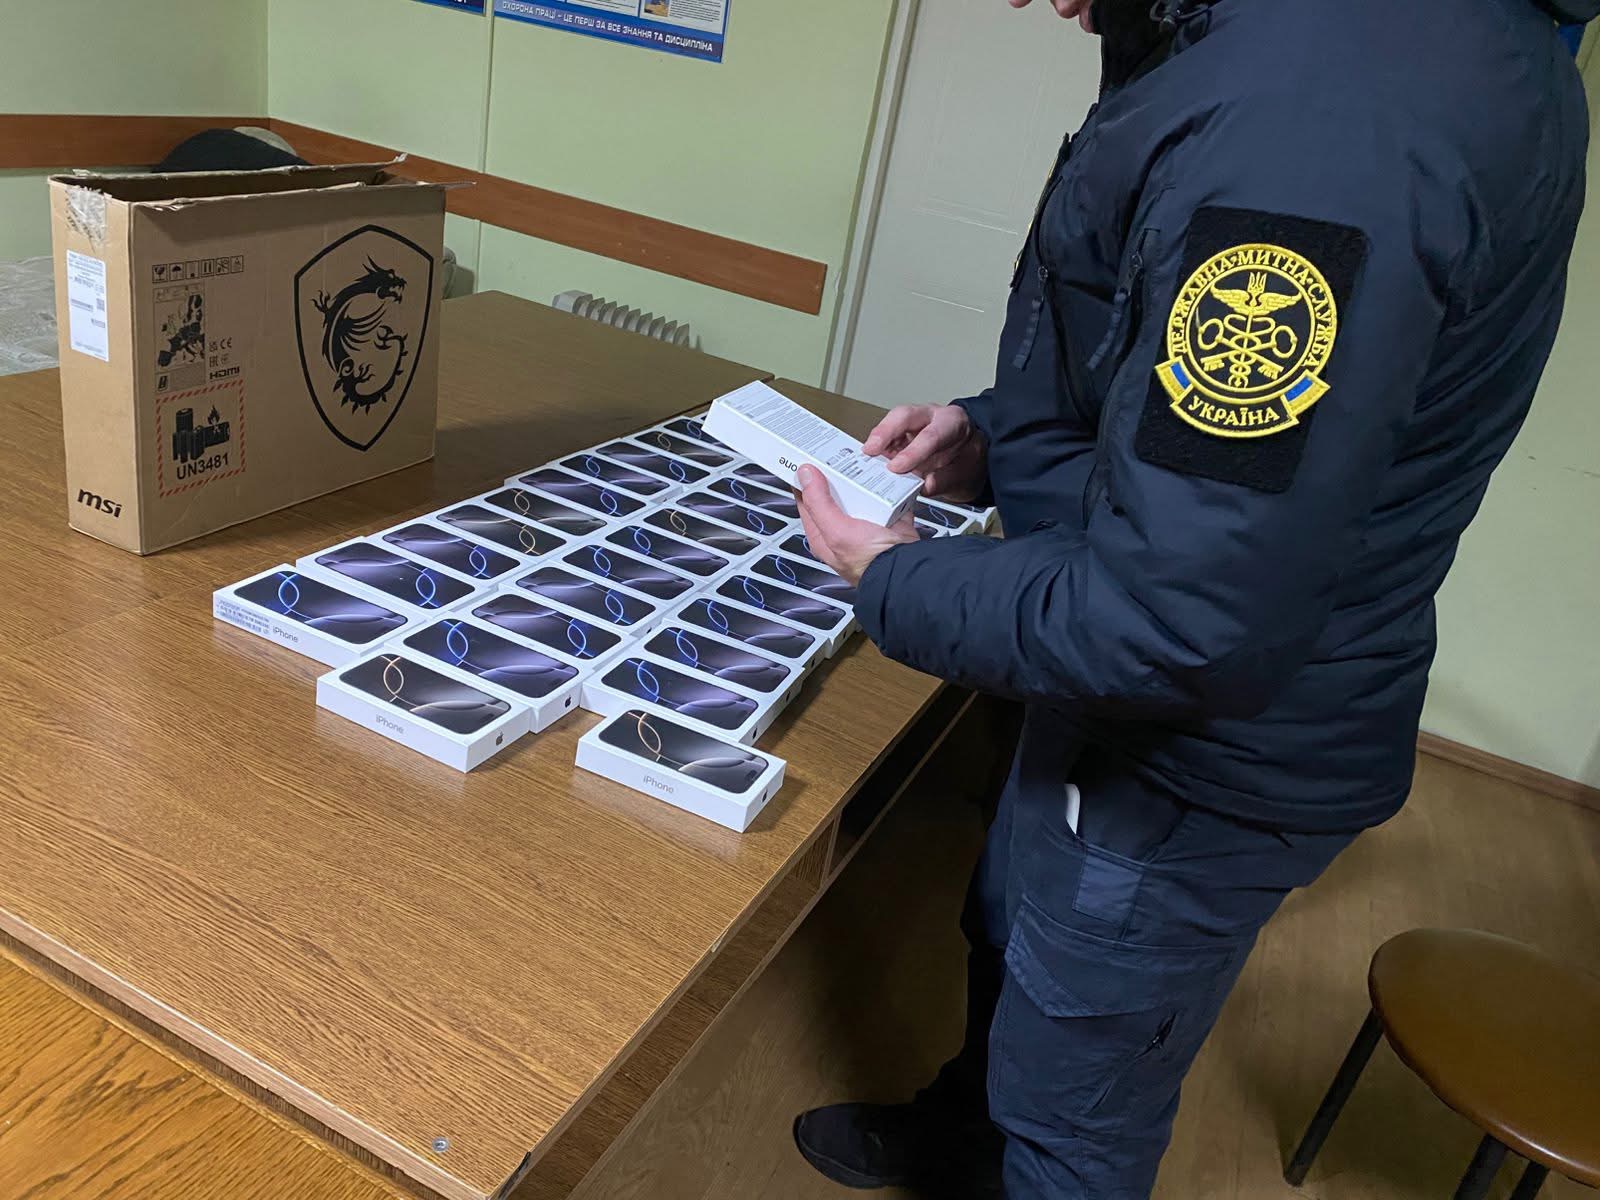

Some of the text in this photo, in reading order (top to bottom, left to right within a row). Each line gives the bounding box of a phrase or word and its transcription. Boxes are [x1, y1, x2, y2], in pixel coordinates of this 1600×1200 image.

[502, 1, 534, 15] ОХОРОНА
[535, 8, 556, 20] ПРАЦІ
[563, 13, 573, 23] ЦЕ
[574, 15, 595, 27] ПЕРШ
[596, 20, 606, 29] ЗА
[607, 22, 621, 33] ВСЕ
[622, 25, 652, 39] ЗНАННЯ
[653, 32, 664, 42] ТА
[664, 35, 713, 52] ДИСЦИПЛІНА
[1238, 249, 1309, 284] МИТНА
[1171, 255, 1235, 354] ДЕРЖАВНА
[1301, 282, 1332, 368] СЛУЖБА
[1188, 395, 1281, 426] УКРАЇНА
[176, 452, 229, 480] UN3481
[77, 488, 123, 518] msi
[272, 626, 299, 643] iPhone
[375, 714, 404, 734] iPhone
[642, 774, 675, 795] iPhone
